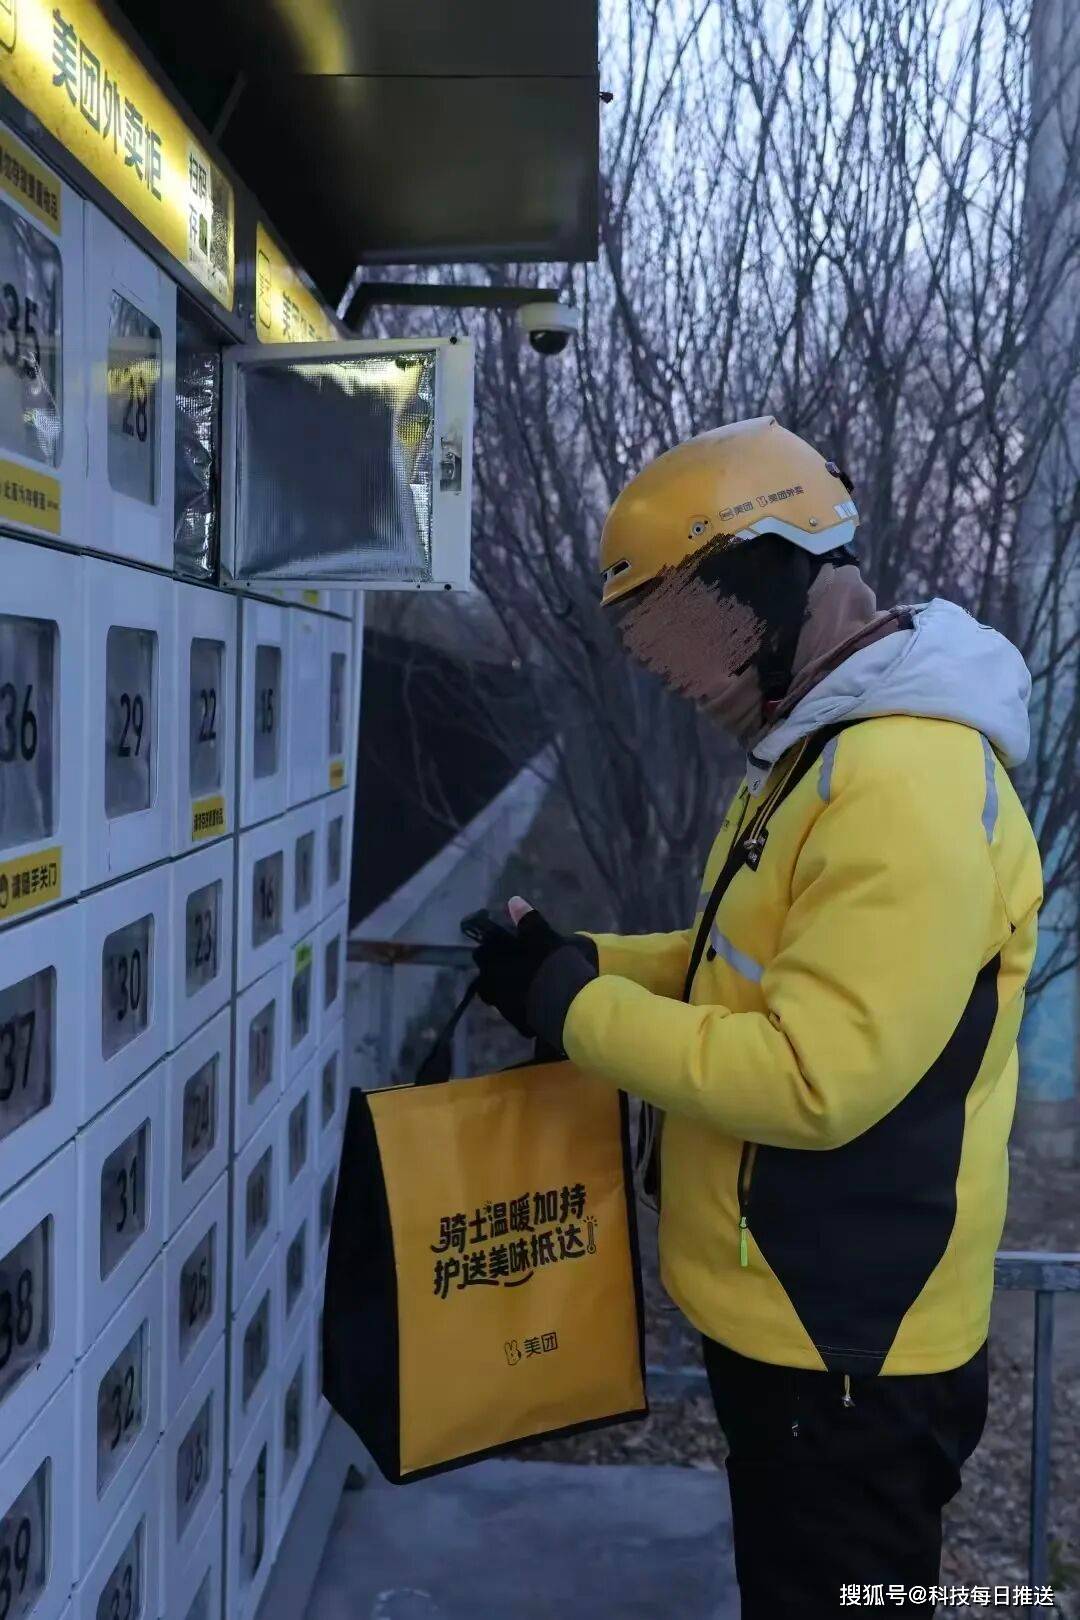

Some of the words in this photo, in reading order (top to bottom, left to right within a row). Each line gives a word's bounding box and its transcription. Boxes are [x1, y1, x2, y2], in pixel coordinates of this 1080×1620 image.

[51, 8, 163, 202] 美团外卖柜
[1, 282, 40, 382] 35
[122, 371, 148, 443] 28
[734, 501, 754, 515] 美团
[768, 485, 805, 504] 美团外卖
[0, 681, 38, 764] 36
[118, 692, 144, 758] 29
[199, 687, 217, 742] 22
[260, 689, 275, 734] 15
[193, 908, 214, 967] 23
[118, 948, 142, 1022] 30
[0, 1010, 35, 1102] 37
[116, 1158, 138, 1233] 31
[430, 1184, 586, 1254] 骑士温暖加持
[523, 1331, 558, 1358] 美团
[110, 1366, 135, 1452] 32
